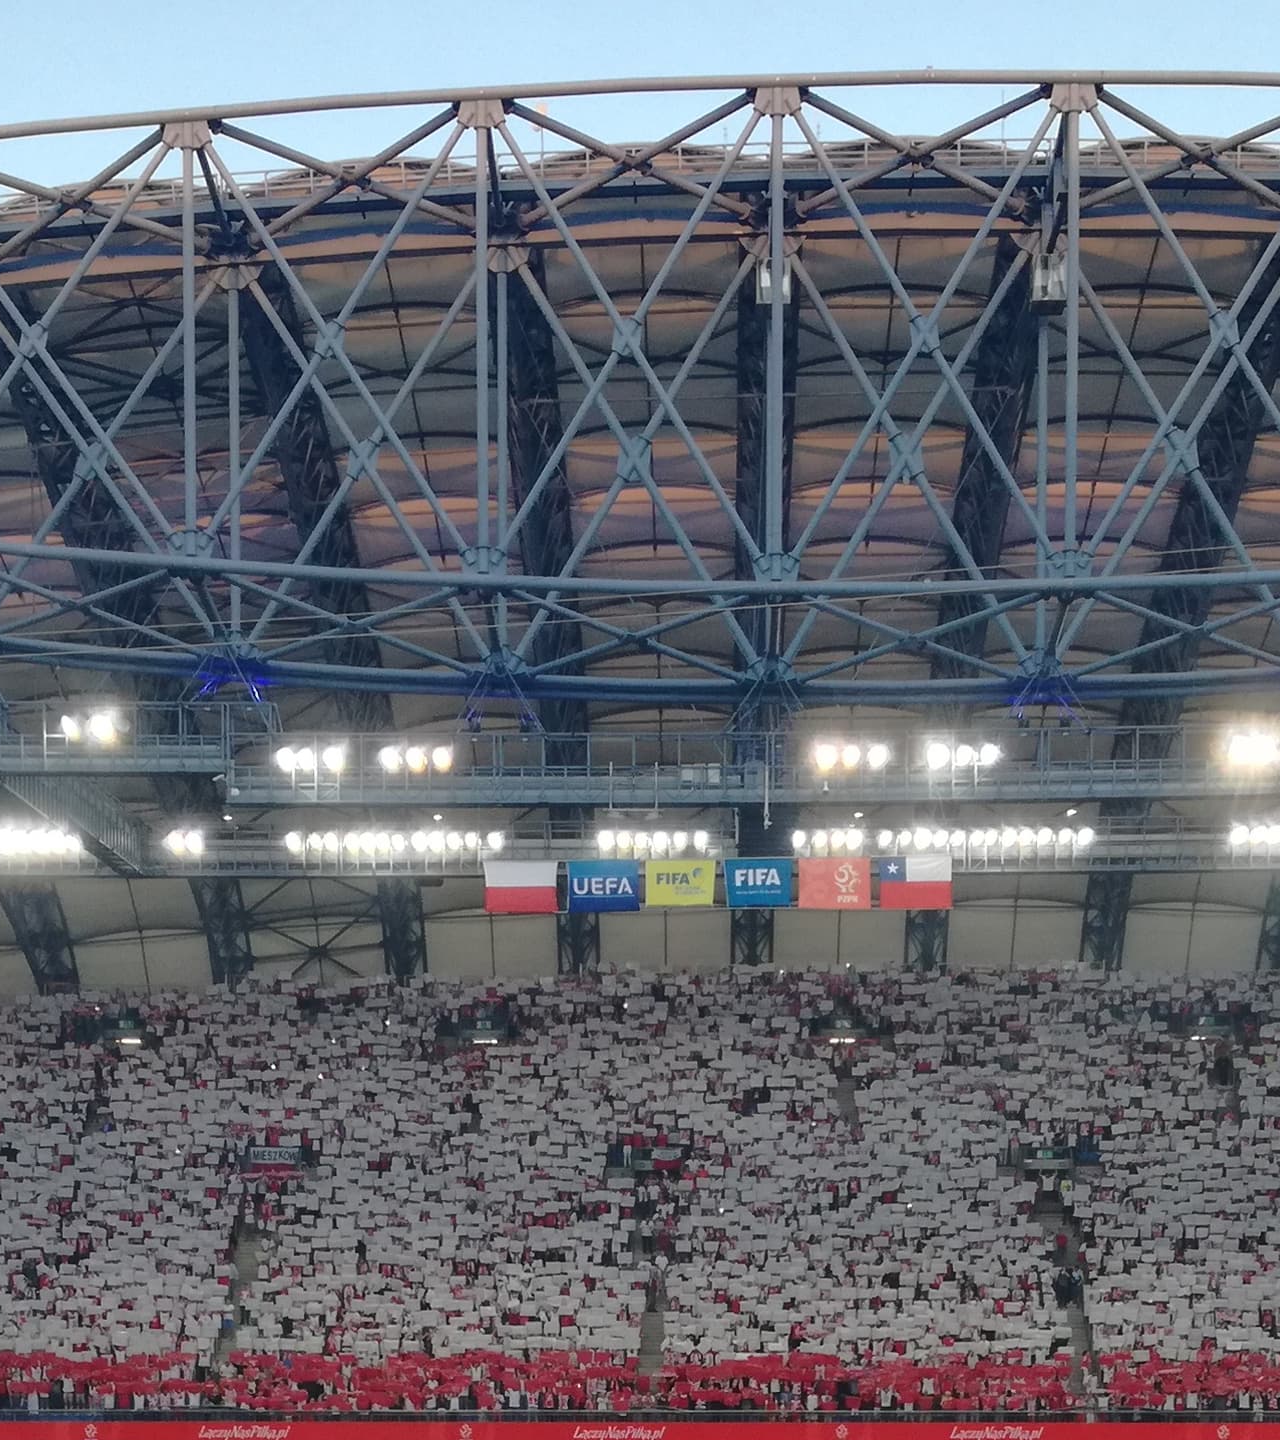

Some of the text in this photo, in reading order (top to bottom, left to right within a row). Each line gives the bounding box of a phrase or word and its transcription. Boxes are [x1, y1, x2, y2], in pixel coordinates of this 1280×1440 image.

[573, 877, 633, 895] UEFA
[656, 873, 689, 885] FIFA
[735, 868, 781, 886] FIFA
